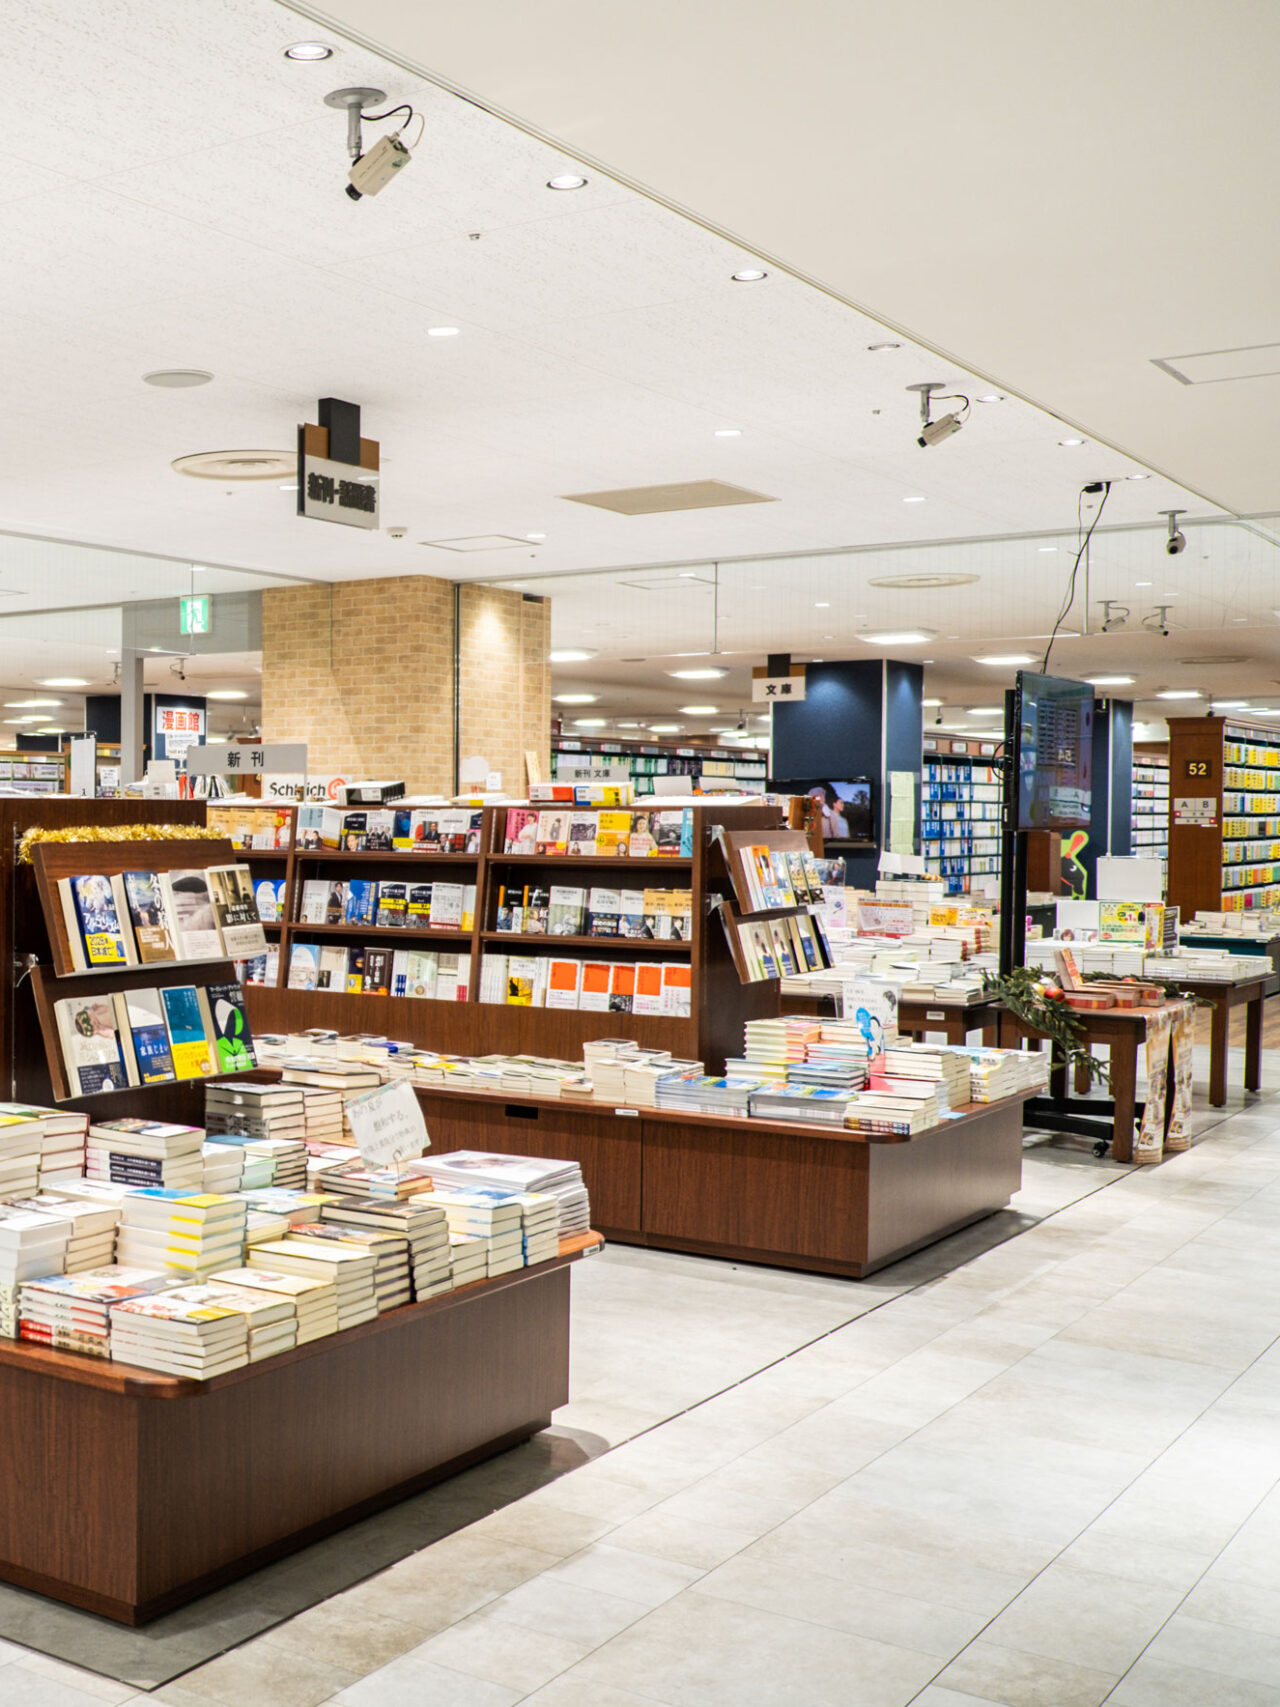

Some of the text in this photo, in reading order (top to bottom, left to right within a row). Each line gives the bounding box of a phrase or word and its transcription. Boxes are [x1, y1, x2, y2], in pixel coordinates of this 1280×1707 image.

[765, 682, 792, 696] 文庫
[162, 711, 200, 731] 漫画館
[227, 751, 264, 768] 新刊
[574, 769, 611, 779] 新刊 文庫
[1188, 763, 1207, 775] 52
[269, 781, 326, 797] Schlich
